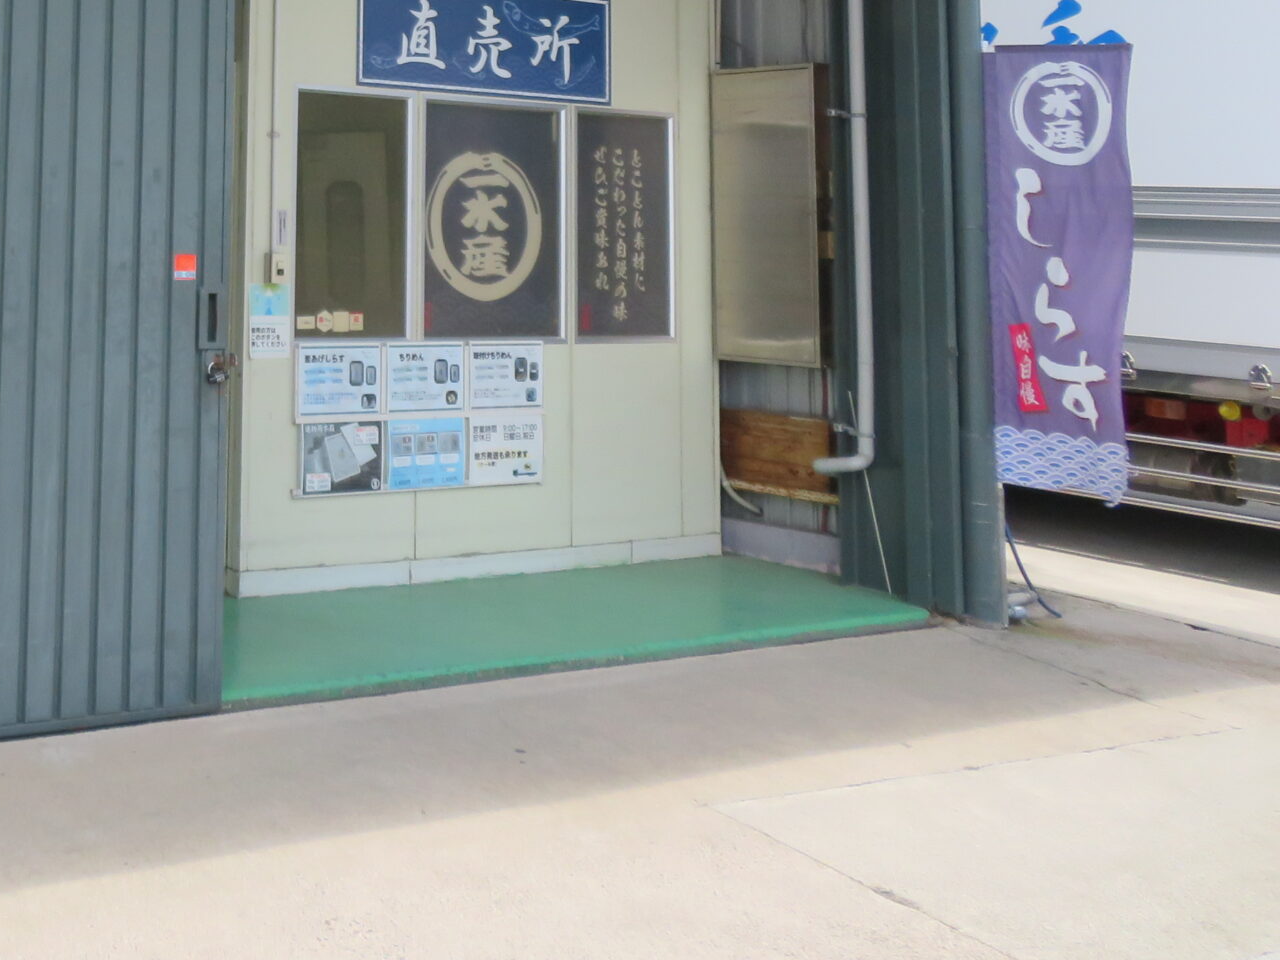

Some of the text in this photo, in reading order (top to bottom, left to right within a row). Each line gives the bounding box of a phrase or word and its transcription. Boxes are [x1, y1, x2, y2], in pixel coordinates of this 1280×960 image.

[1037, 76, 1087, 151] 一水産
[459, 173, 511, 279] 一水産
[612, 147, 629, 321] こだわった自慢の味
[631, 148, 646, 292] とことん素材に
[1014, 167, 1108, 433] しらす
[1016, 332, 1040, 406] 味自慢
